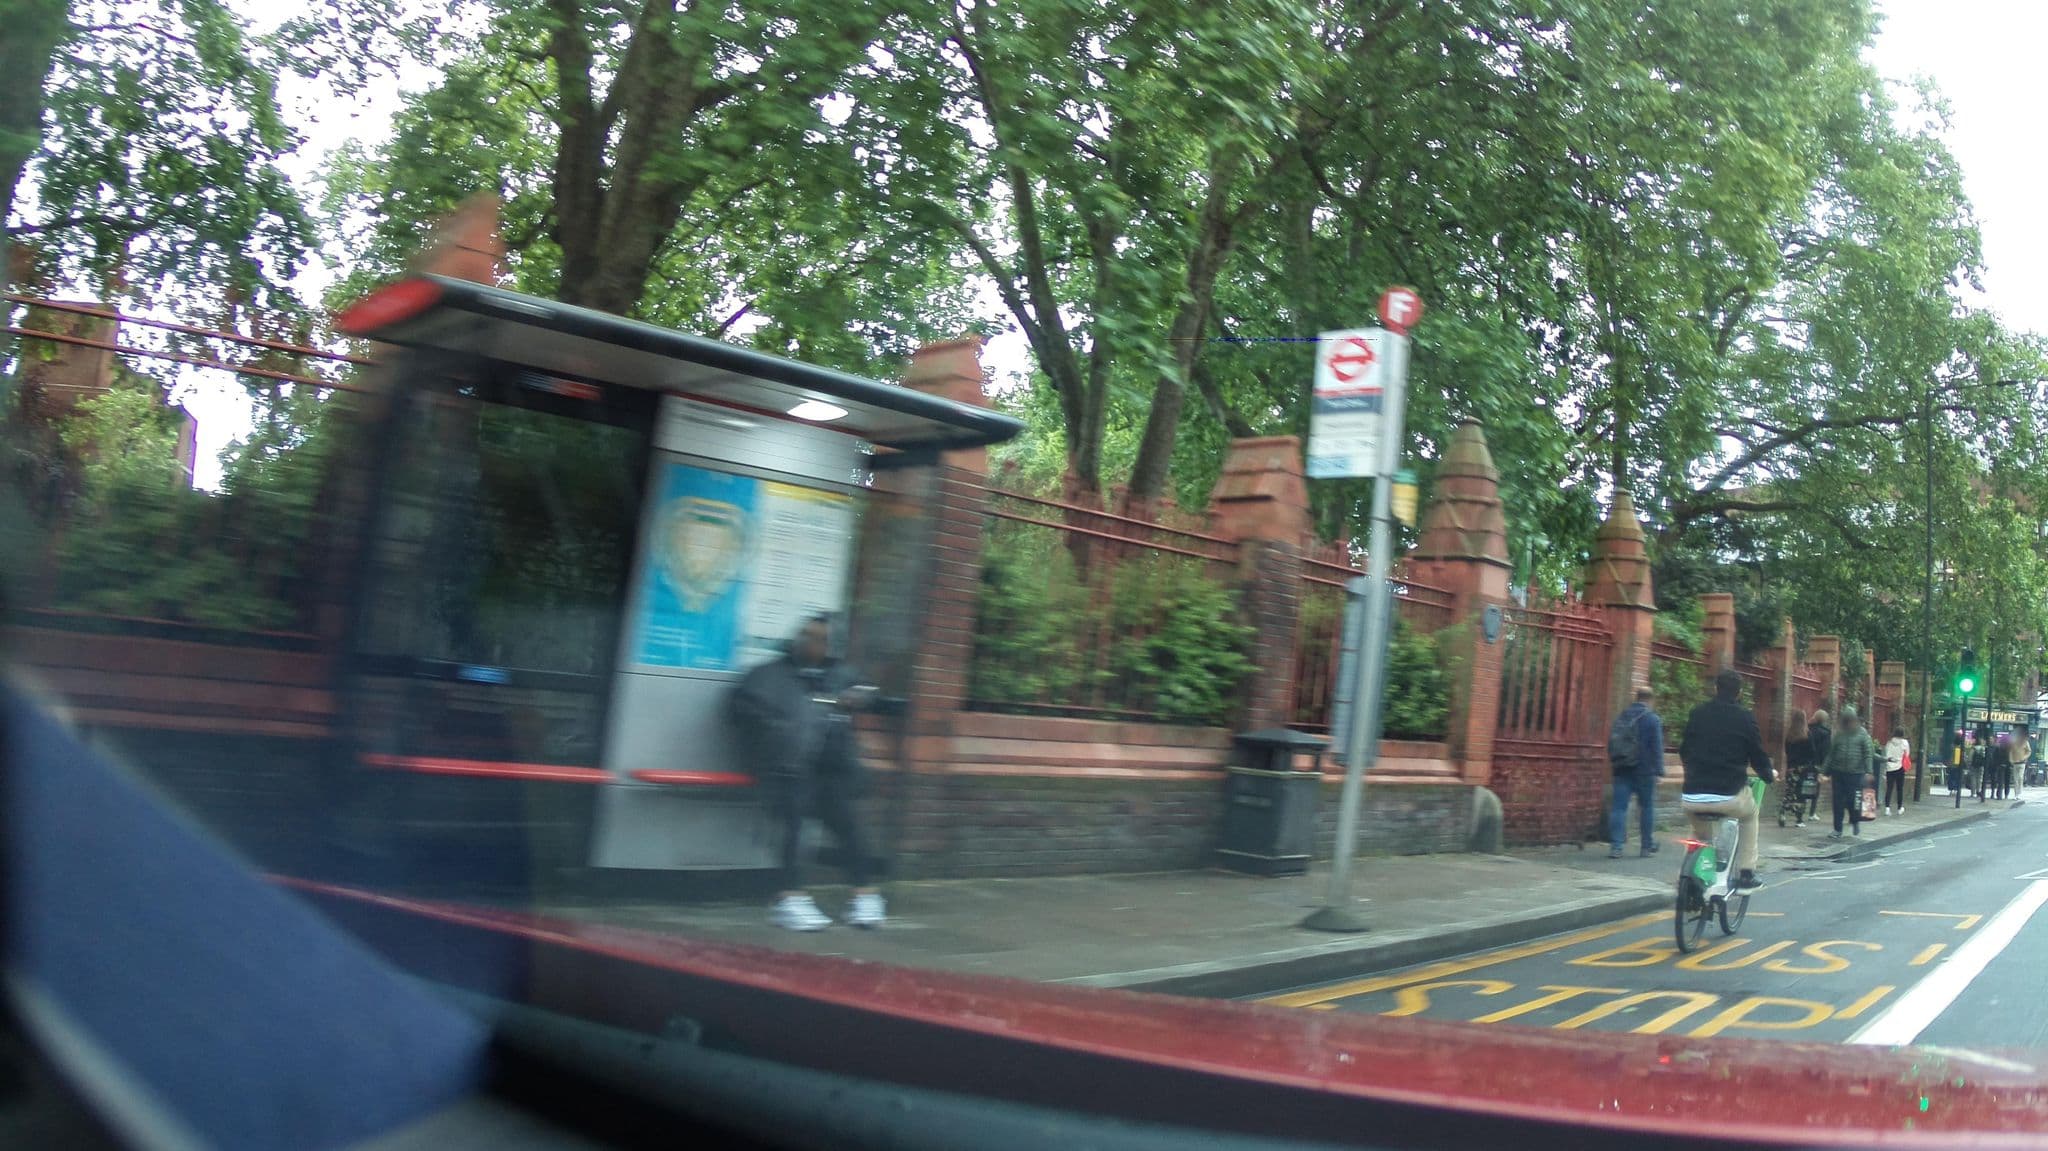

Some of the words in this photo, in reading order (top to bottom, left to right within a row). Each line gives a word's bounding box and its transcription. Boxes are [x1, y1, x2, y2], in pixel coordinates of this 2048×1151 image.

[1388, 291, 1414, 323] F
[1567, 937, 1882, 974] BUS
[1379, 980, 1837, 1037] STOP
